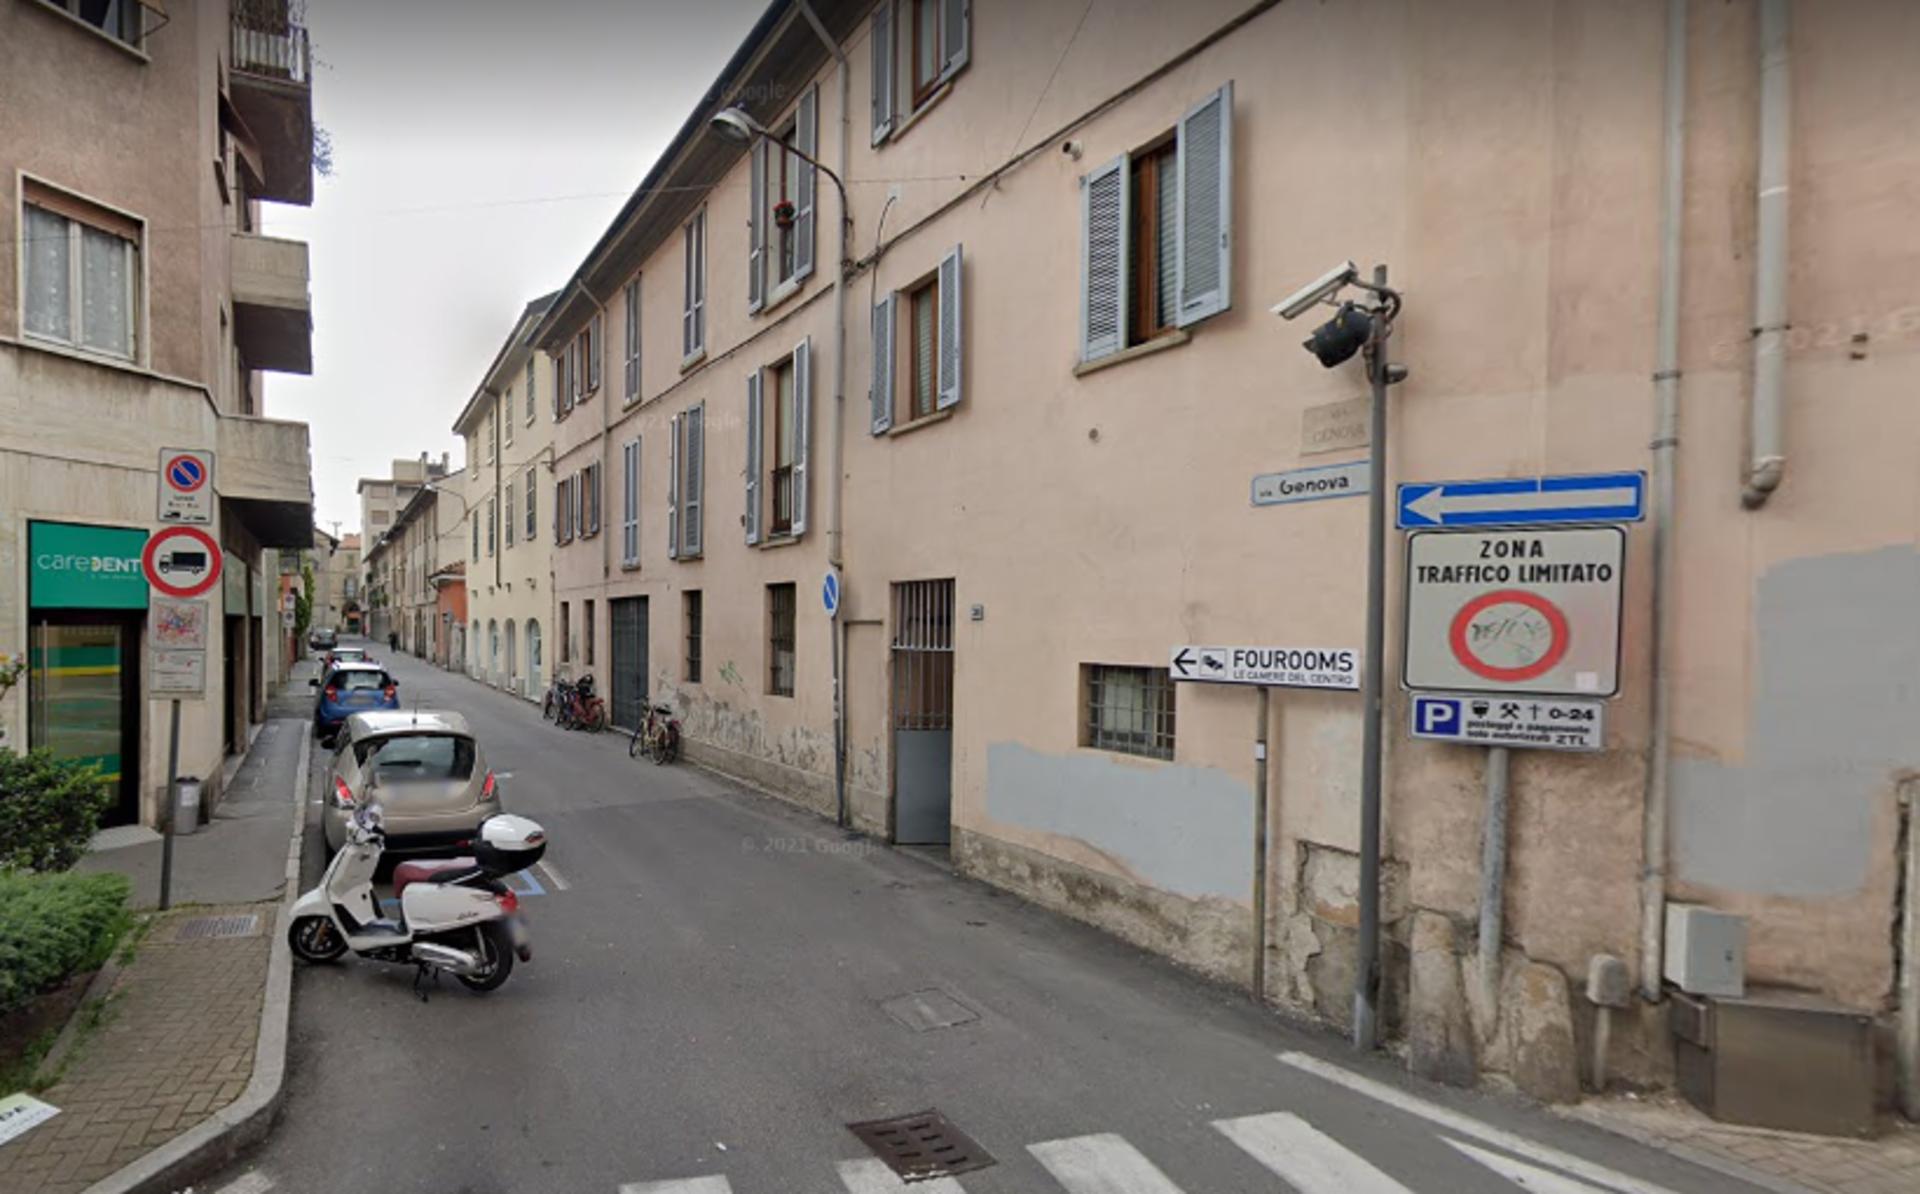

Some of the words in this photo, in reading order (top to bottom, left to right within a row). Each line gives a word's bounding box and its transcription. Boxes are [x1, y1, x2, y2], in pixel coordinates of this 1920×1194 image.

[1279, 476, 1350, 495] Genova
[1479, 540, 1544, 558] ZONA
[1416, 564, 1510, 584] TRAFFICO
[1518, 563, 1613, 583] LIMITATO
[1233, 649, 1354, 673] FOUROOMS
[1424, 702, 1453, 732] P
[1549, 708, 1595, 722] 0-24
[1556, 734, 1588, 746] ZTL
